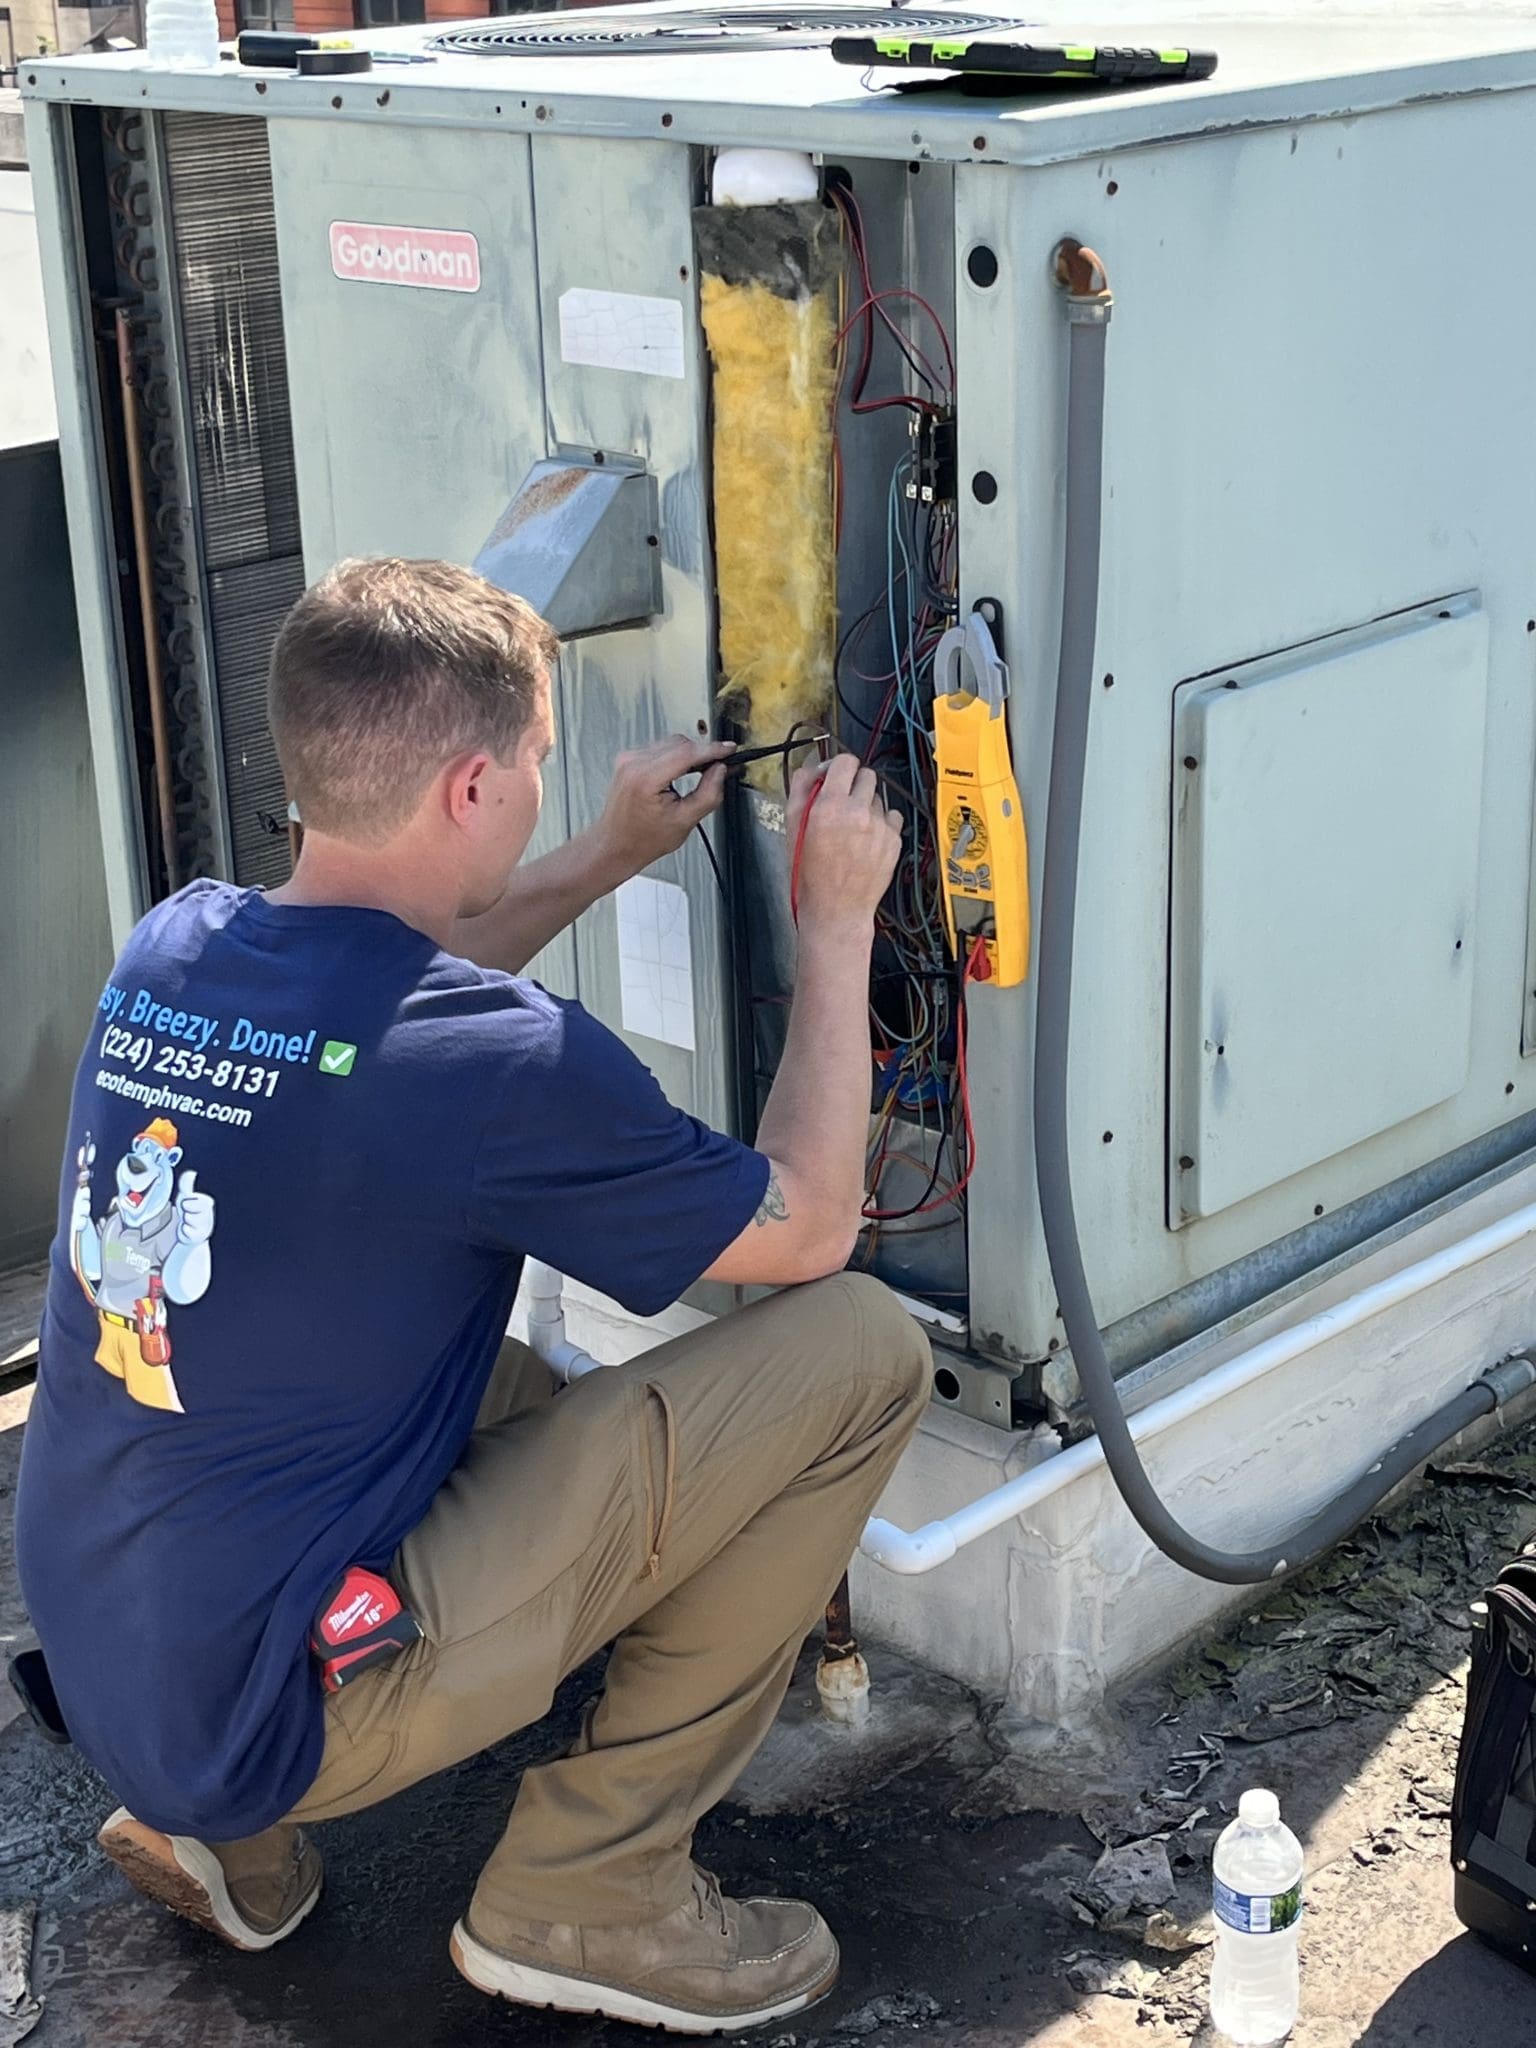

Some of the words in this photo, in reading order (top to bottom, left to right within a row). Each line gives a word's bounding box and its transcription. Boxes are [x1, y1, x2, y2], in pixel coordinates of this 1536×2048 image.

[337, 233, 473, 279] Goodman
[129, 989, 220, 1052] Breezy.
[228, 1018, 317, 1064] Done!
[100, 1023, 154, 1073] (224)
[153, 1045, 280, 1098] 253-8131
[95, 1069, 252, 1128] ecotemphvac.com
